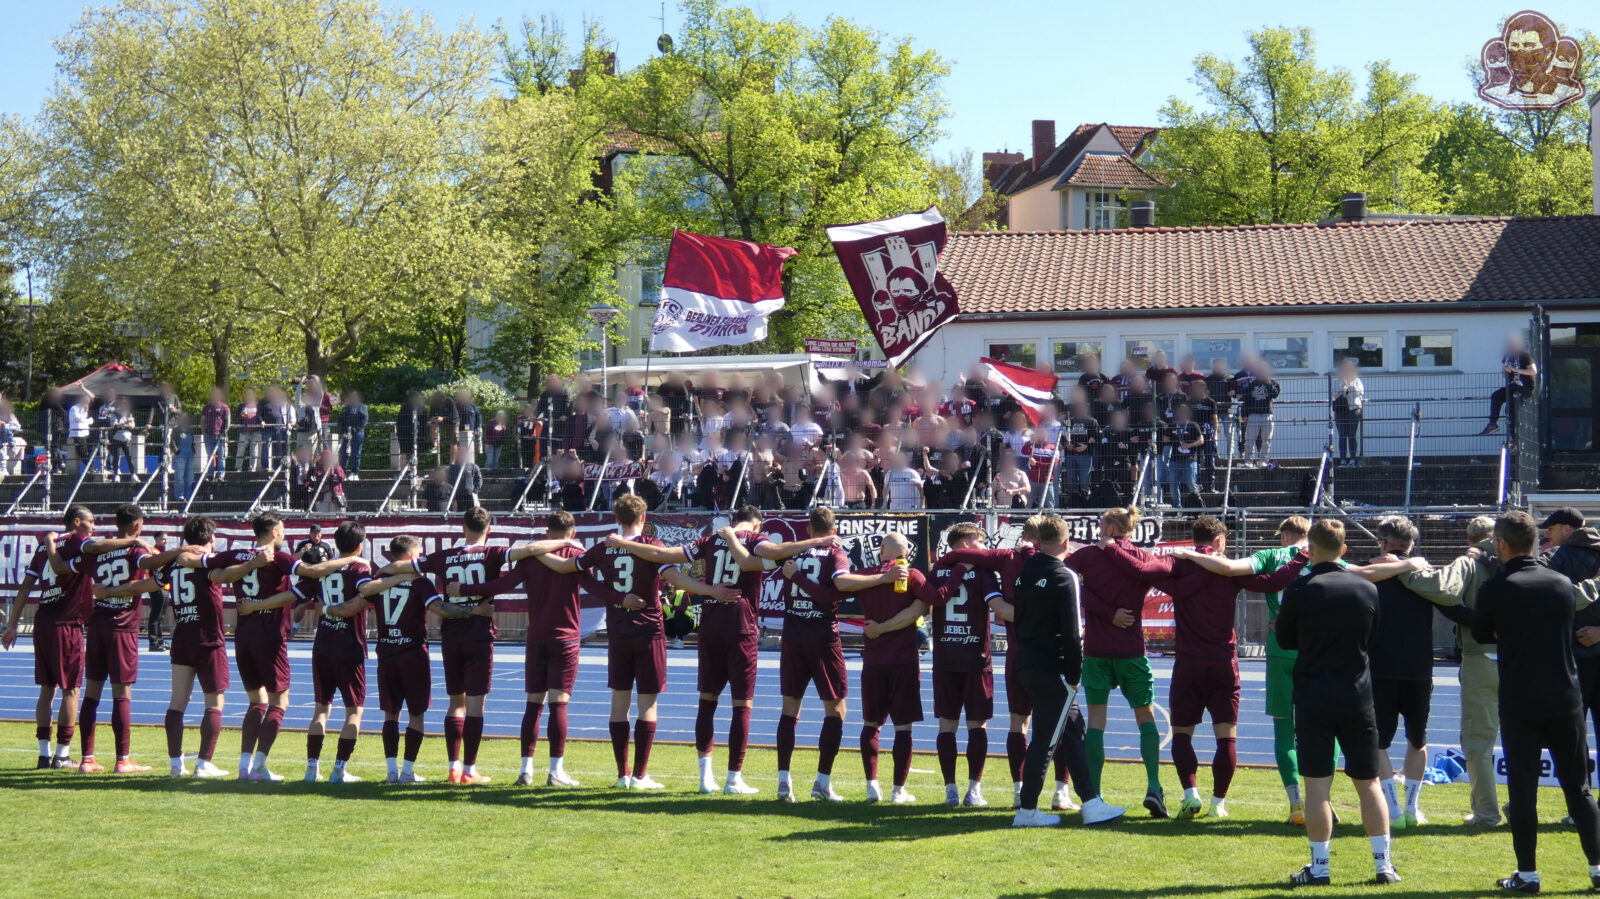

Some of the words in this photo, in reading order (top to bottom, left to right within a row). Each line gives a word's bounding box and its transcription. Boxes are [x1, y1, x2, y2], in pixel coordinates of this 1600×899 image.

[685, 310, 721, 326] BERLINER
[688, 323, 748, 338] DYNAMO
[42, 559, 58, 586] 4
[97, 559, 130, 587] 22
[445, 556, 458, 564] BFC
[459, 552, 485, 562] DYNAMO
[936, 569, 951, 578] BFC
[170, 567, 196, 606] 15
[319, 572, 344, 607] 18
[445, 562, 486, 604] 20
[613, 555, 635, 593] 3
[379, 586, 410, 625] 17
[945, 581, 969, 622] 2
